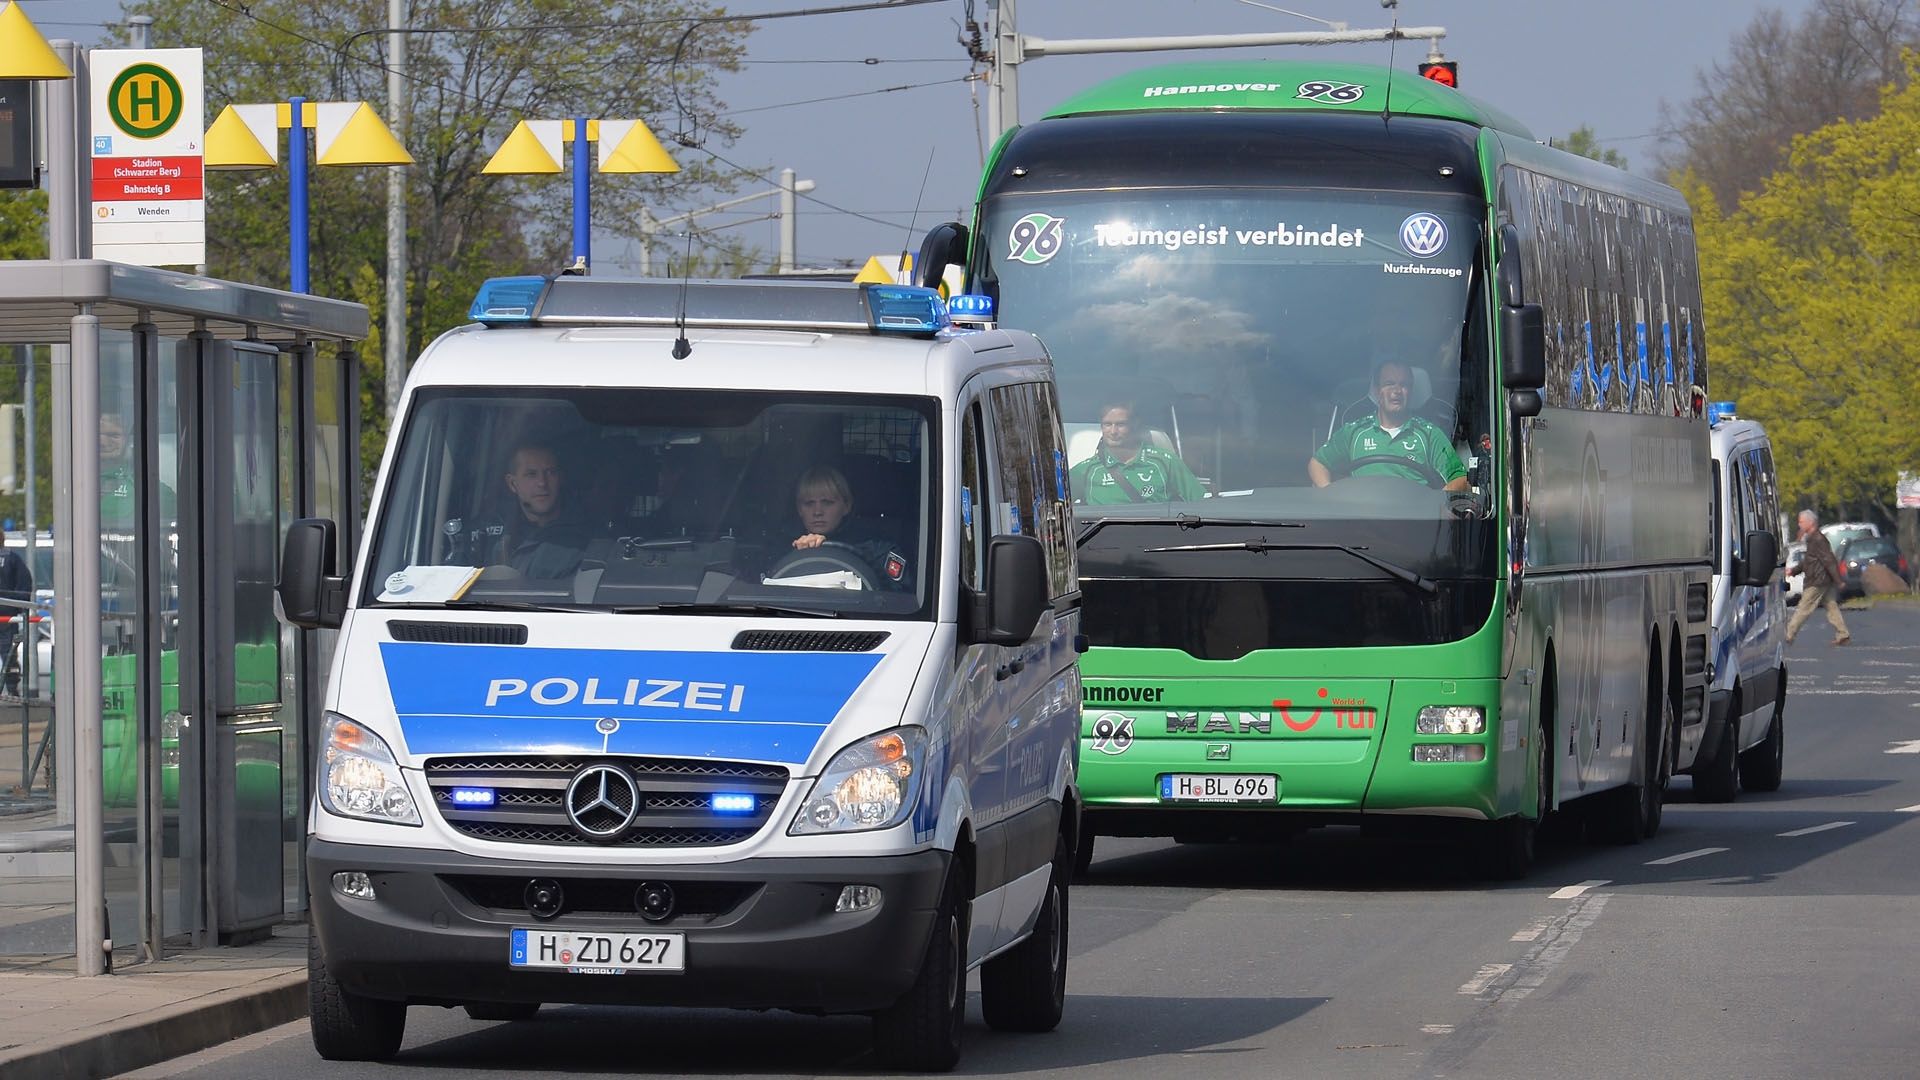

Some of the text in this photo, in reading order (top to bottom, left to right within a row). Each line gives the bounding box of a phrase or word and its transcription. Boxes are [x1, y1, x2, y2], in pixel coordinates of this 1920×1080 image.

[1143, 82, 1281, 98] Hannover
[1292, 80, 1368, 104] 96
[129, 80, 160, 122] H
[95, 140, 106, 149] 40
[132, 158, 163, 168] Stadion
[113, 167, 181, 178] (Schwarzer Berg)
[123, 184, 171, 196] Bahnsteig B
[111, 208, 115, 216] 1
[137, 207, 170, 216] Wenden
[1007, 216, 1064, 260] 96
[1094, 223, 1364, 251] Teamgeist verbindet
[1384, 263, 1462, 278] Nutzfahrzeuge
[1141, 485, 1154, 497] 96
[485, 677, 745, 713] POLIZEI
[1082, 686, 1164, 702] nnover
[1166, 712, 1272, 734] MAN
[1091, 715, 1135, 752] 96
[1180, 778, 1192, 795] H
[1205, 778, 1229, 796] BL
[1234, 779, 1268, 796] 696
[516, 936, 671, 964] D H ZD 627
